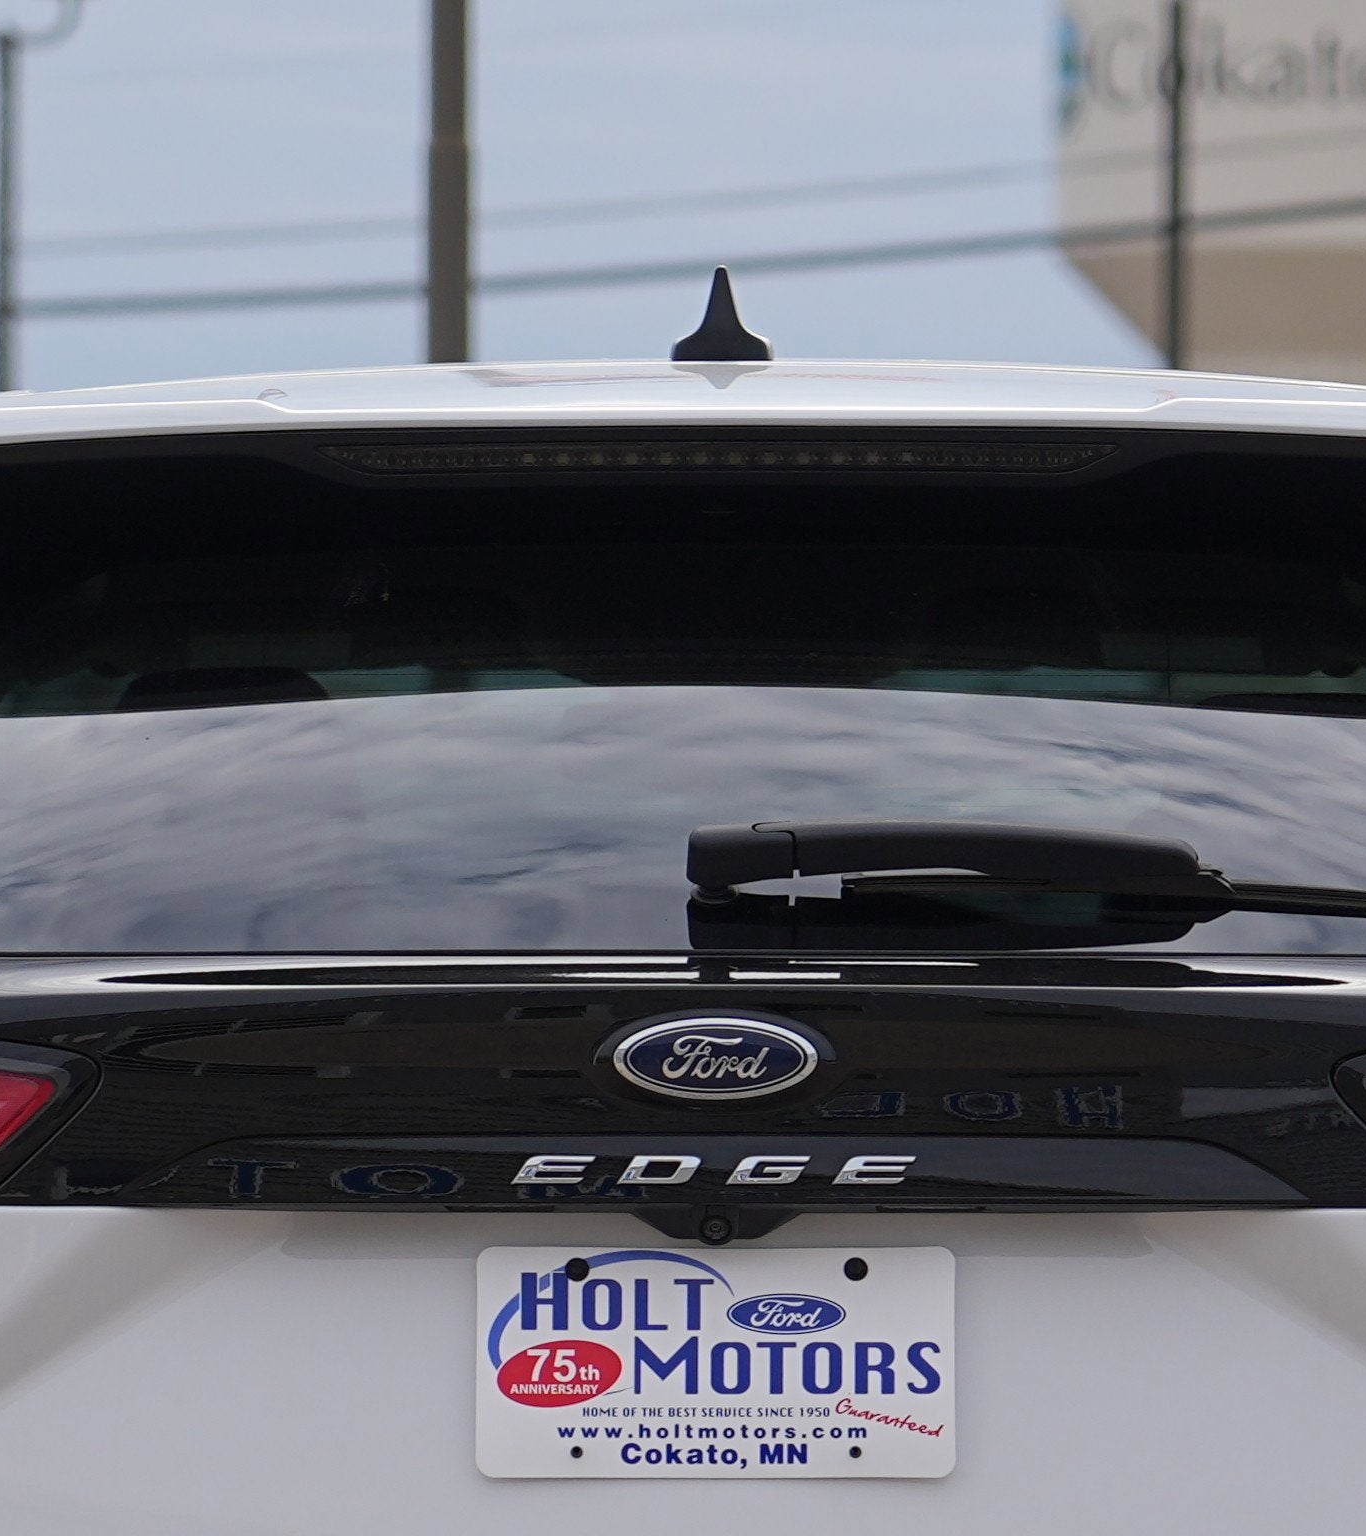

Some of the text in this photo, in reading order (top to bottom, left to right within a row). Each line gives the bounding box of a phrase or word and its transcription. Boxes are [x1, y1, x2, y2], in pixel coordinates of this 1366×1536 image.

[661, 1034, 771, 1080] Ford
[511, 1154, 918, 1187] EDGE
[520, 1271, 715, 1331] HOLT
[749, 1300, 823, 1329] Ford
[526, 1348, 601, 1383] 75th
[633, 1336, 942, 1396] MOTORS
[509, 1383, 599, 1397] ANNIVERSARY
[582, 1406, 830, 1418] HOME OF THE BEST SERVICE SINCE 1950
[835, 1397, 944, 1438] Guaranteed
[557, 1424, 868, 1439] www.holtmotors.com
[621, 1443, 808, 1469] Cokato, MN
